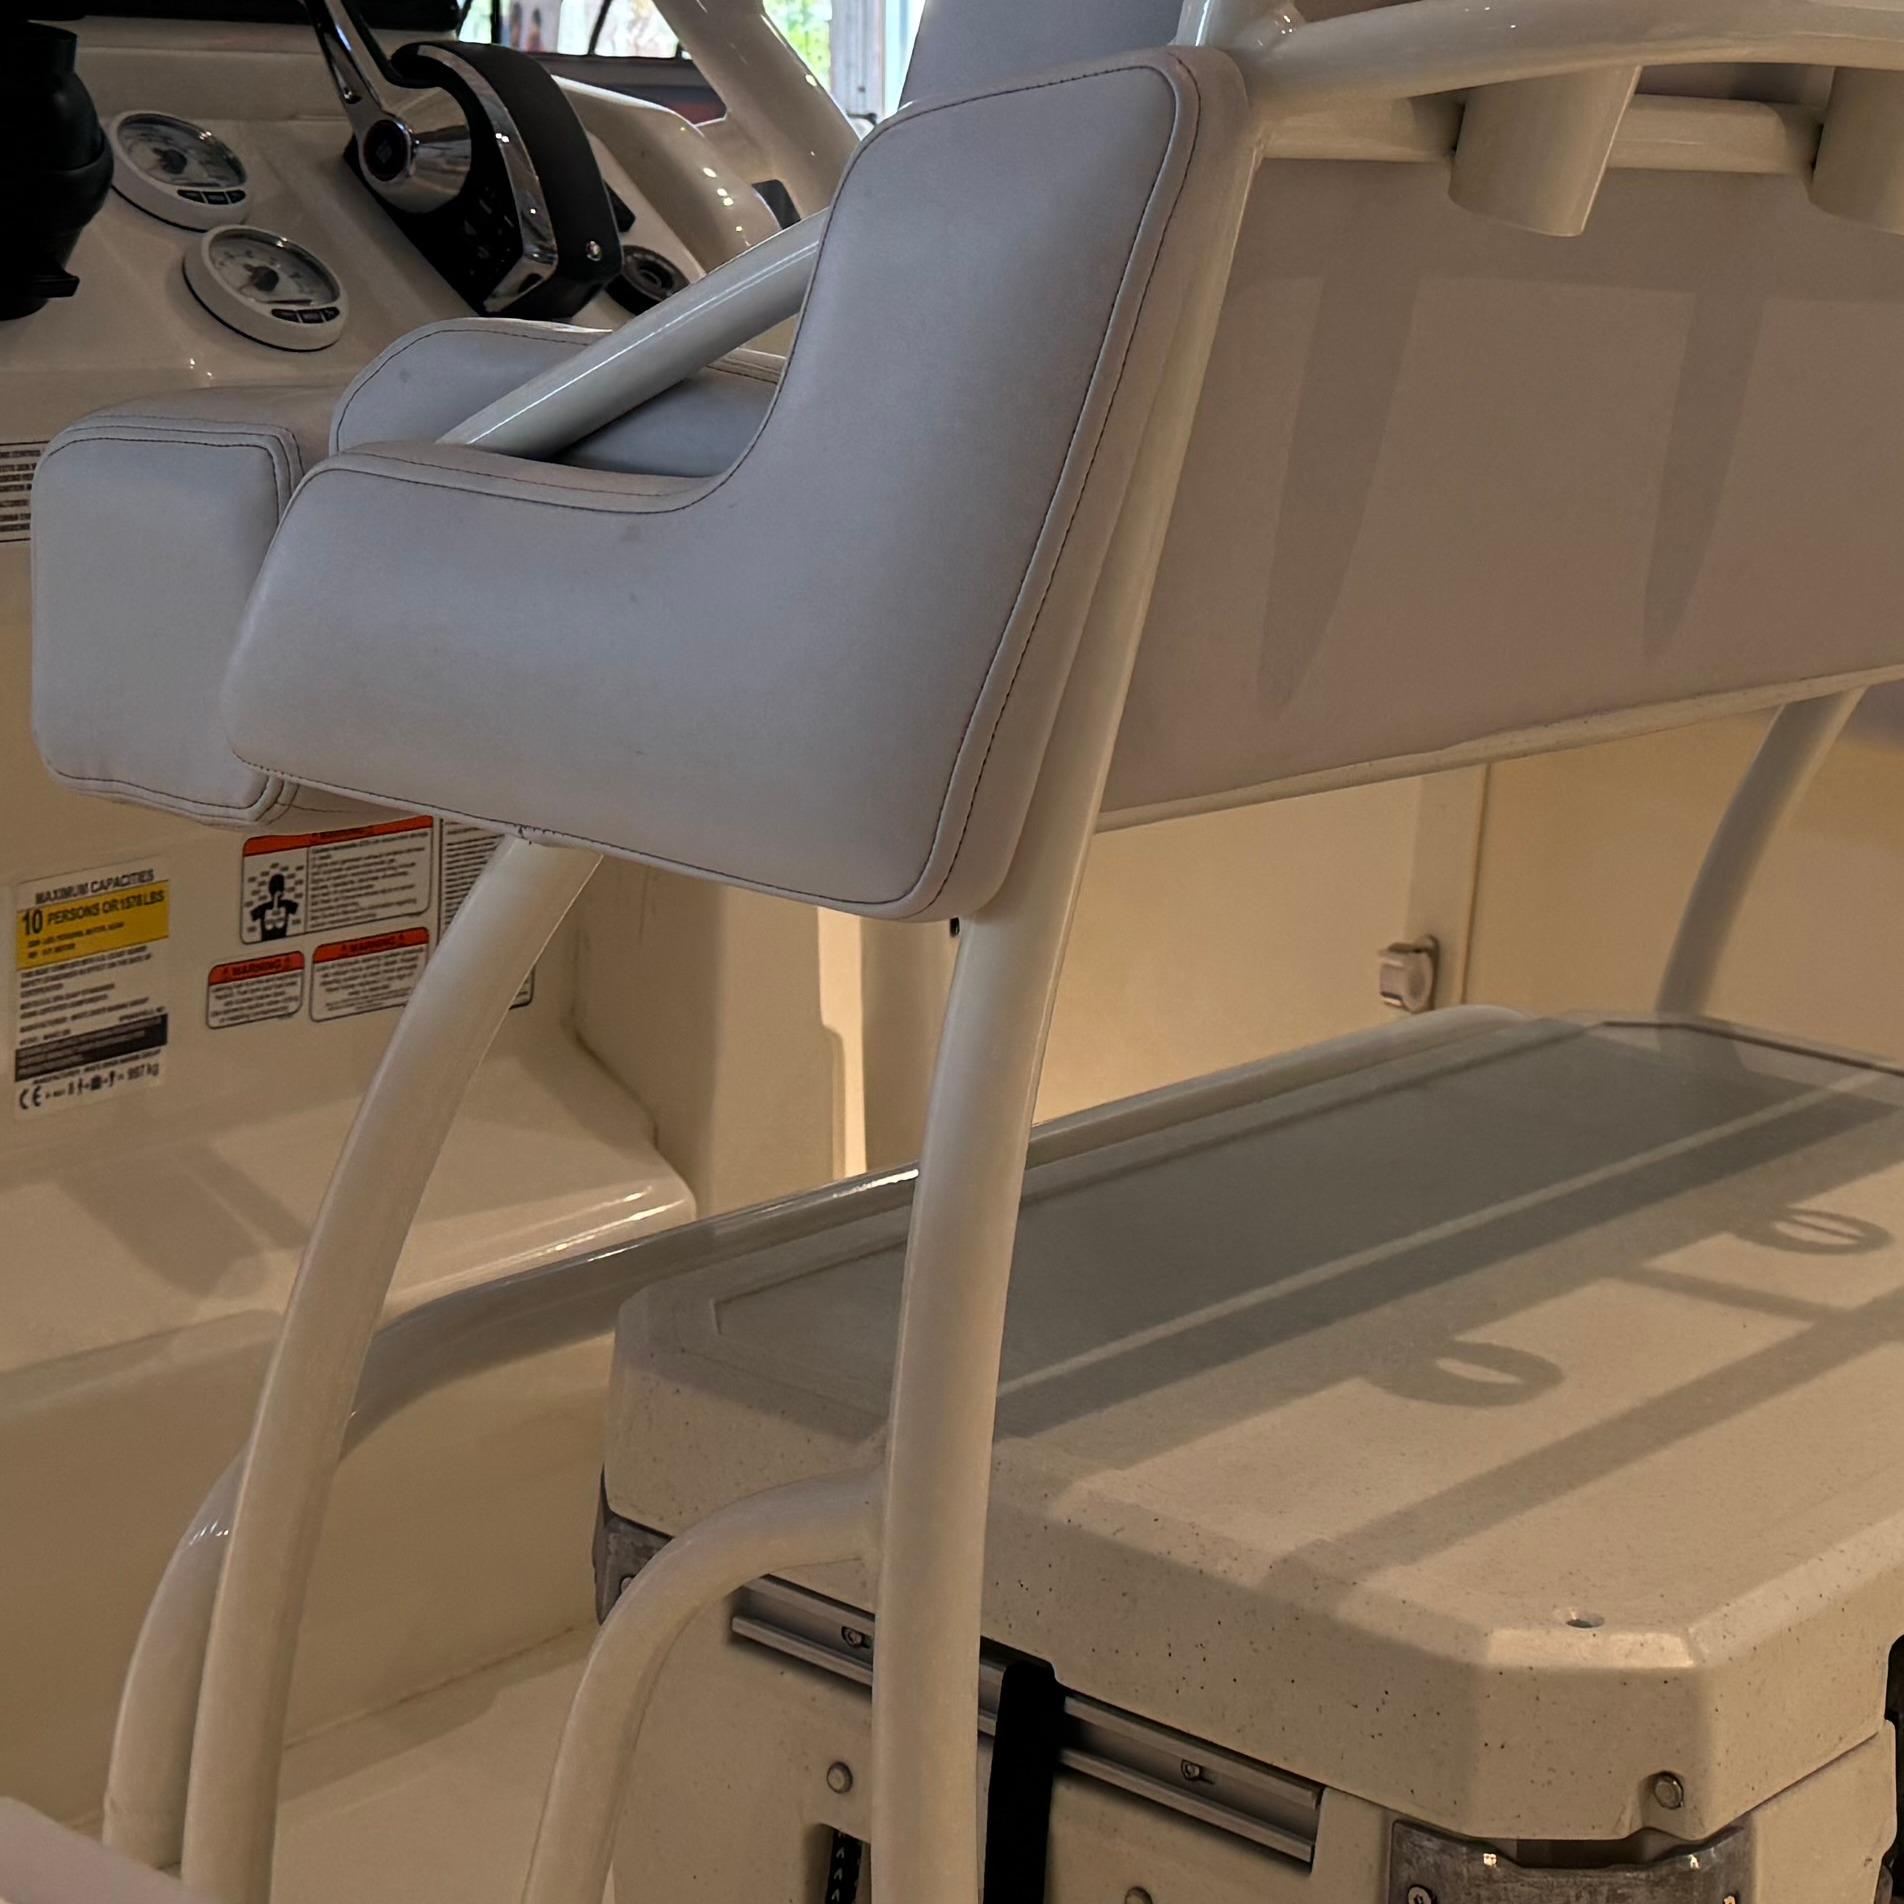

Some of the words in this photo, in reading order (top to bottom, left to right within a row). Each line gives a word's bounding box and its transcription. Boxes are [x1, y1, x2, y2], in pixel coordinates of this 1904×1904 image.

[35, 883, 89, 905] MAXIMUM
[90, 869, 155, 893] CAPACITIES
[21, 908, 43, 936] 10
[47, 902, 100, 925] PERSONS
